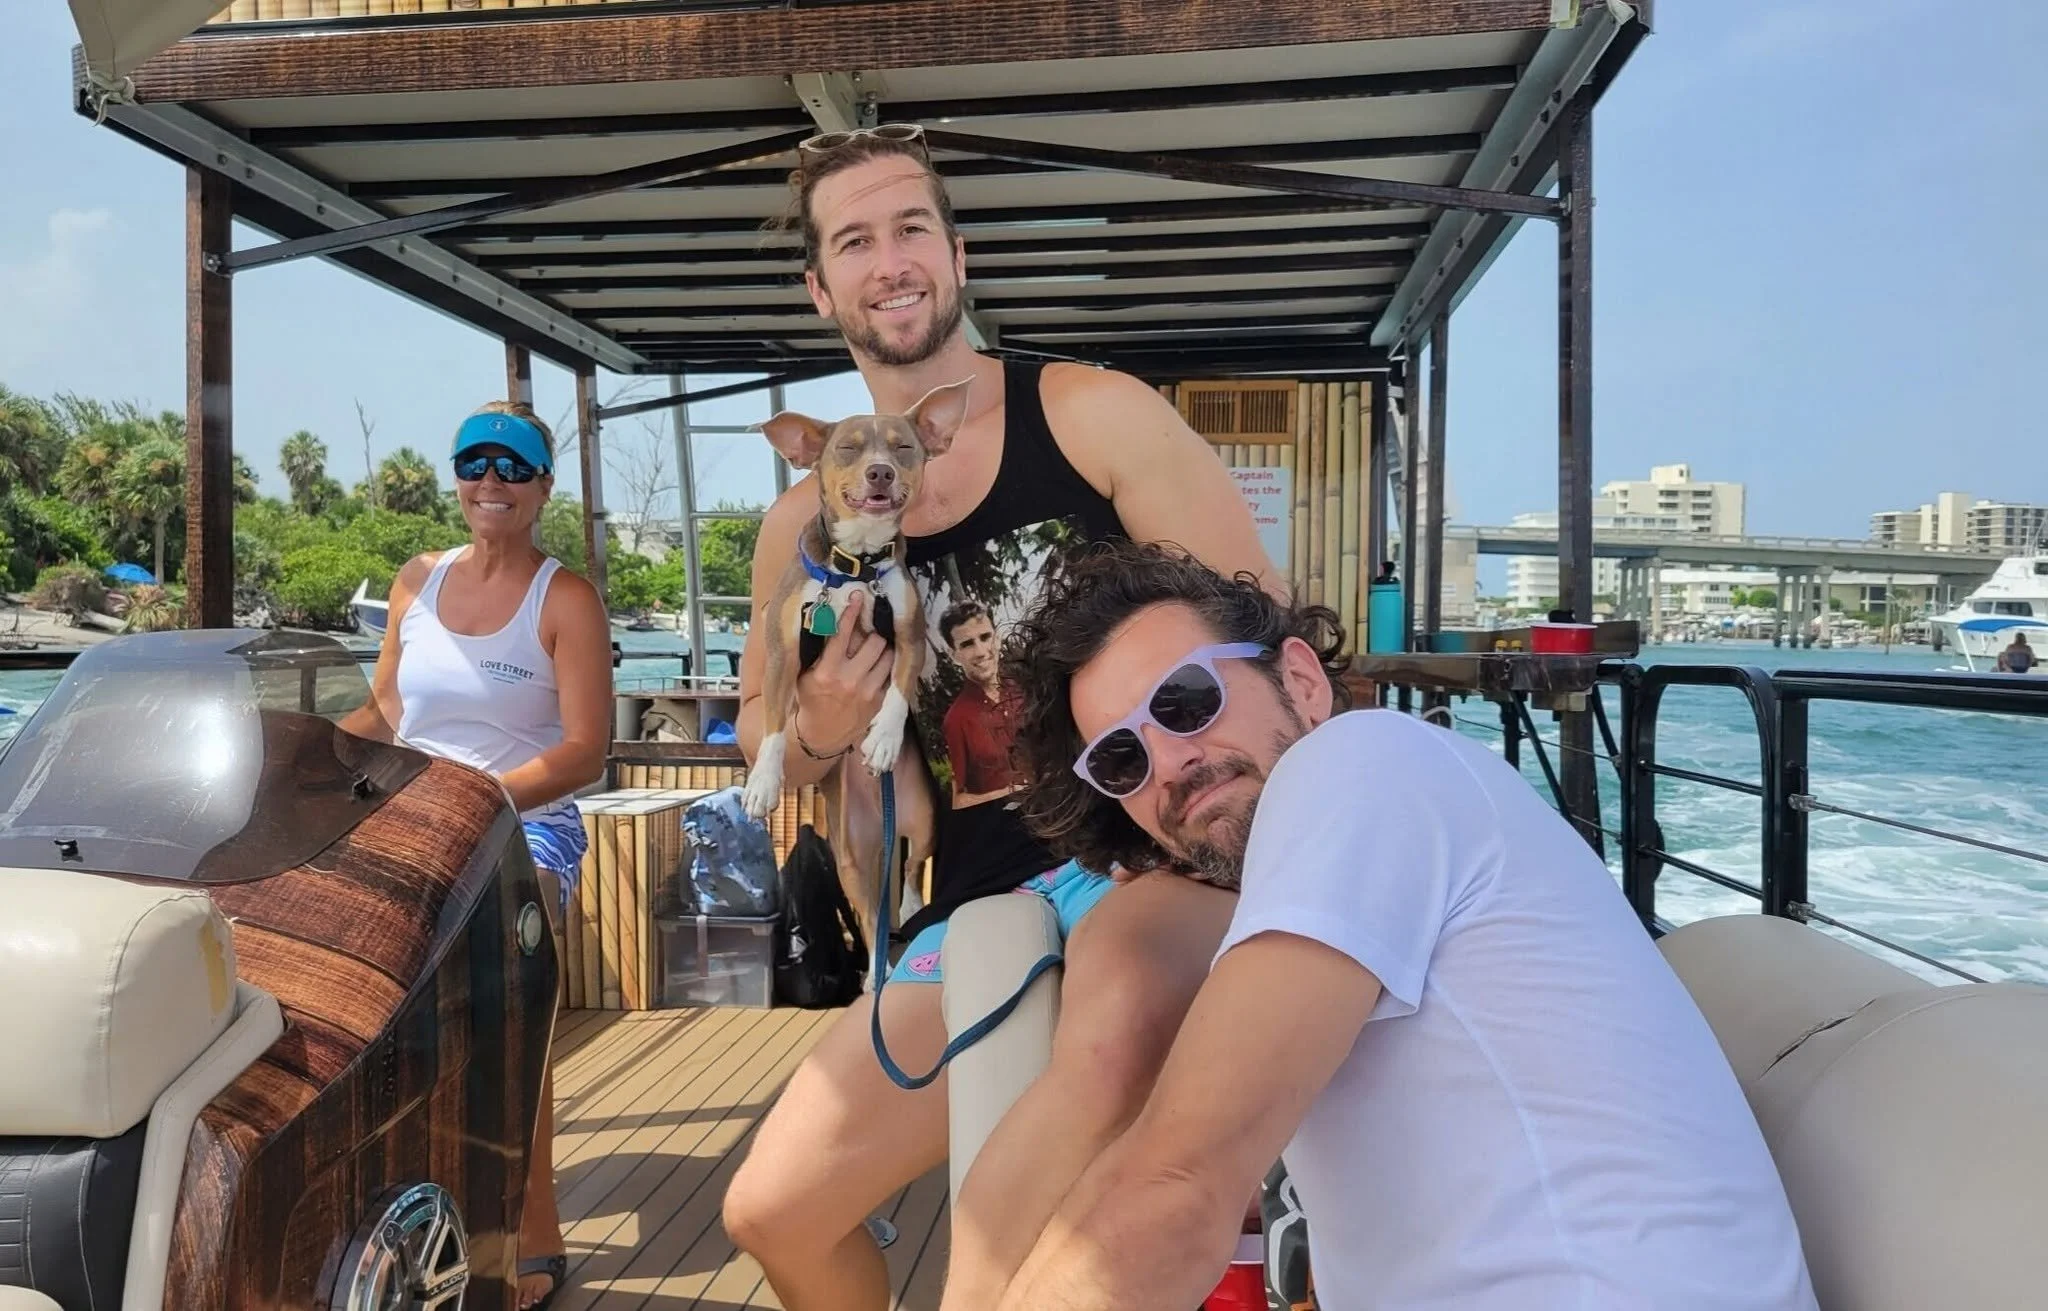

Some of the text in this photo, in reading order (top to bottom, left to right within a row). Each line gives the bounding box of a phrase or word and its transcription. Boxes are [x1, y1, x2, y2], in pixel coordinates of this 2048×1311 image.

[1263, 485, 1282, 495] the
[480, 660, 501, 671] LOVE
[502, 663, 534, 680] STREET
